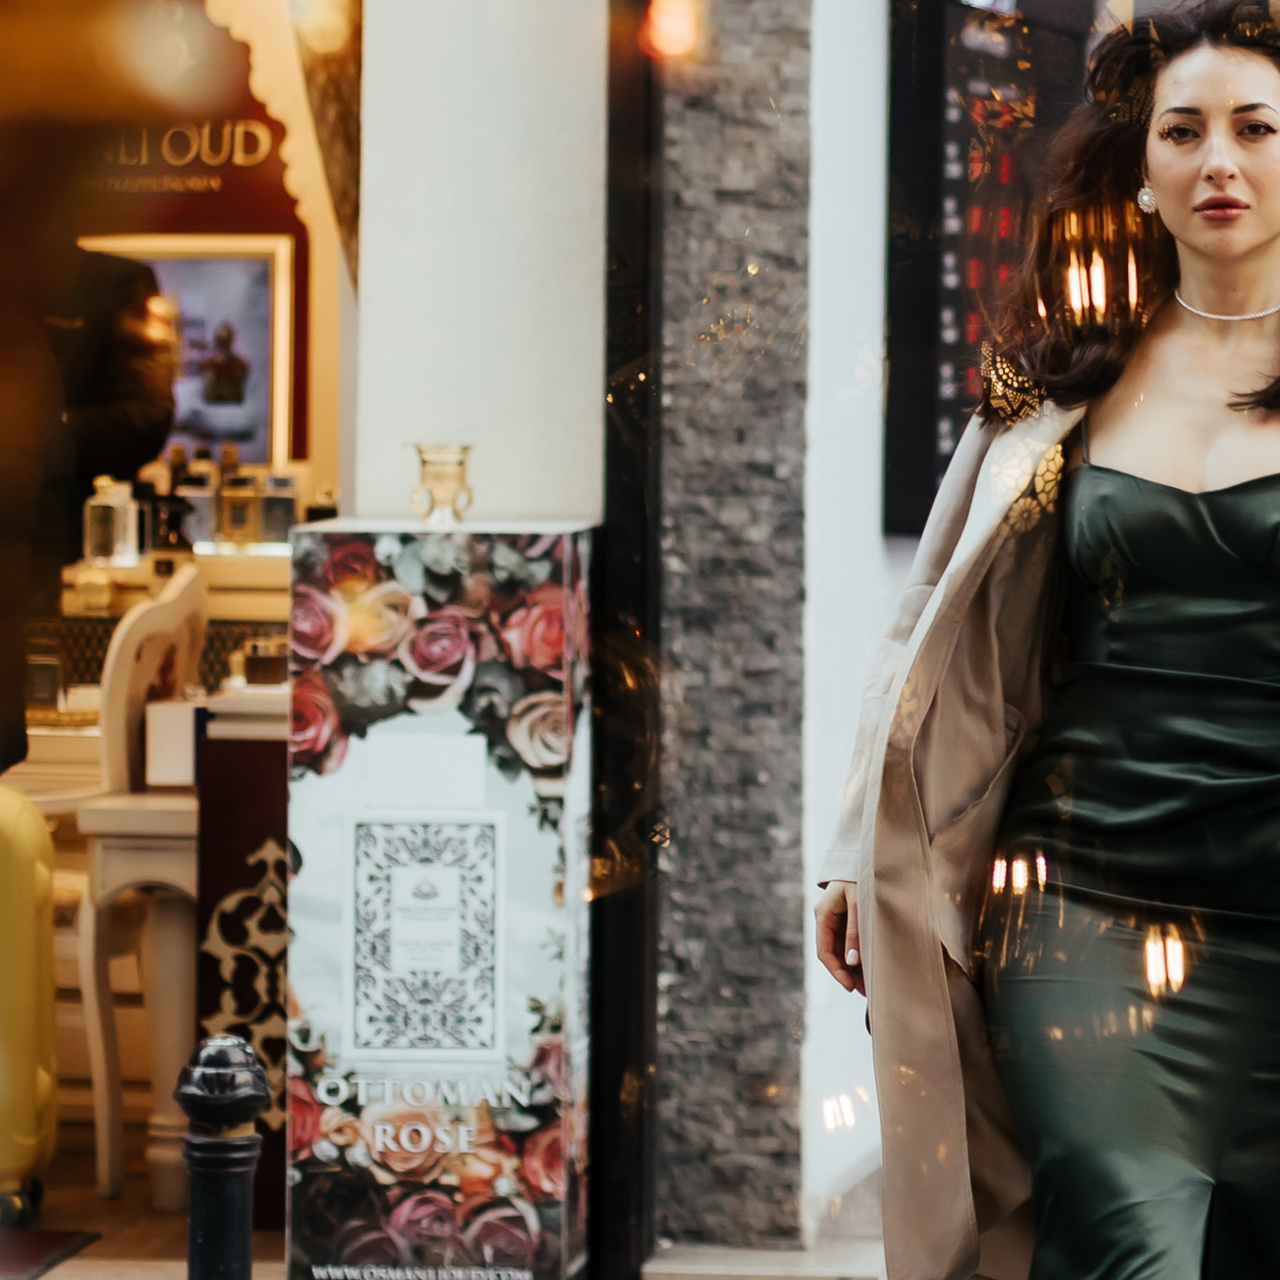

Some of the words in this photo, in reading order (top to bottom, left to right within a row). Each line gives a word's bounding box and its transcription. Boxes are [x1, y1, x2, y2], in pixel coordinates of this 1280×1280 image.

[160, 119, 273, 168] OUD
[316, 1075, 532, 1108] OTTOMAN
[372, 1122, 477, 1154] ROSE
